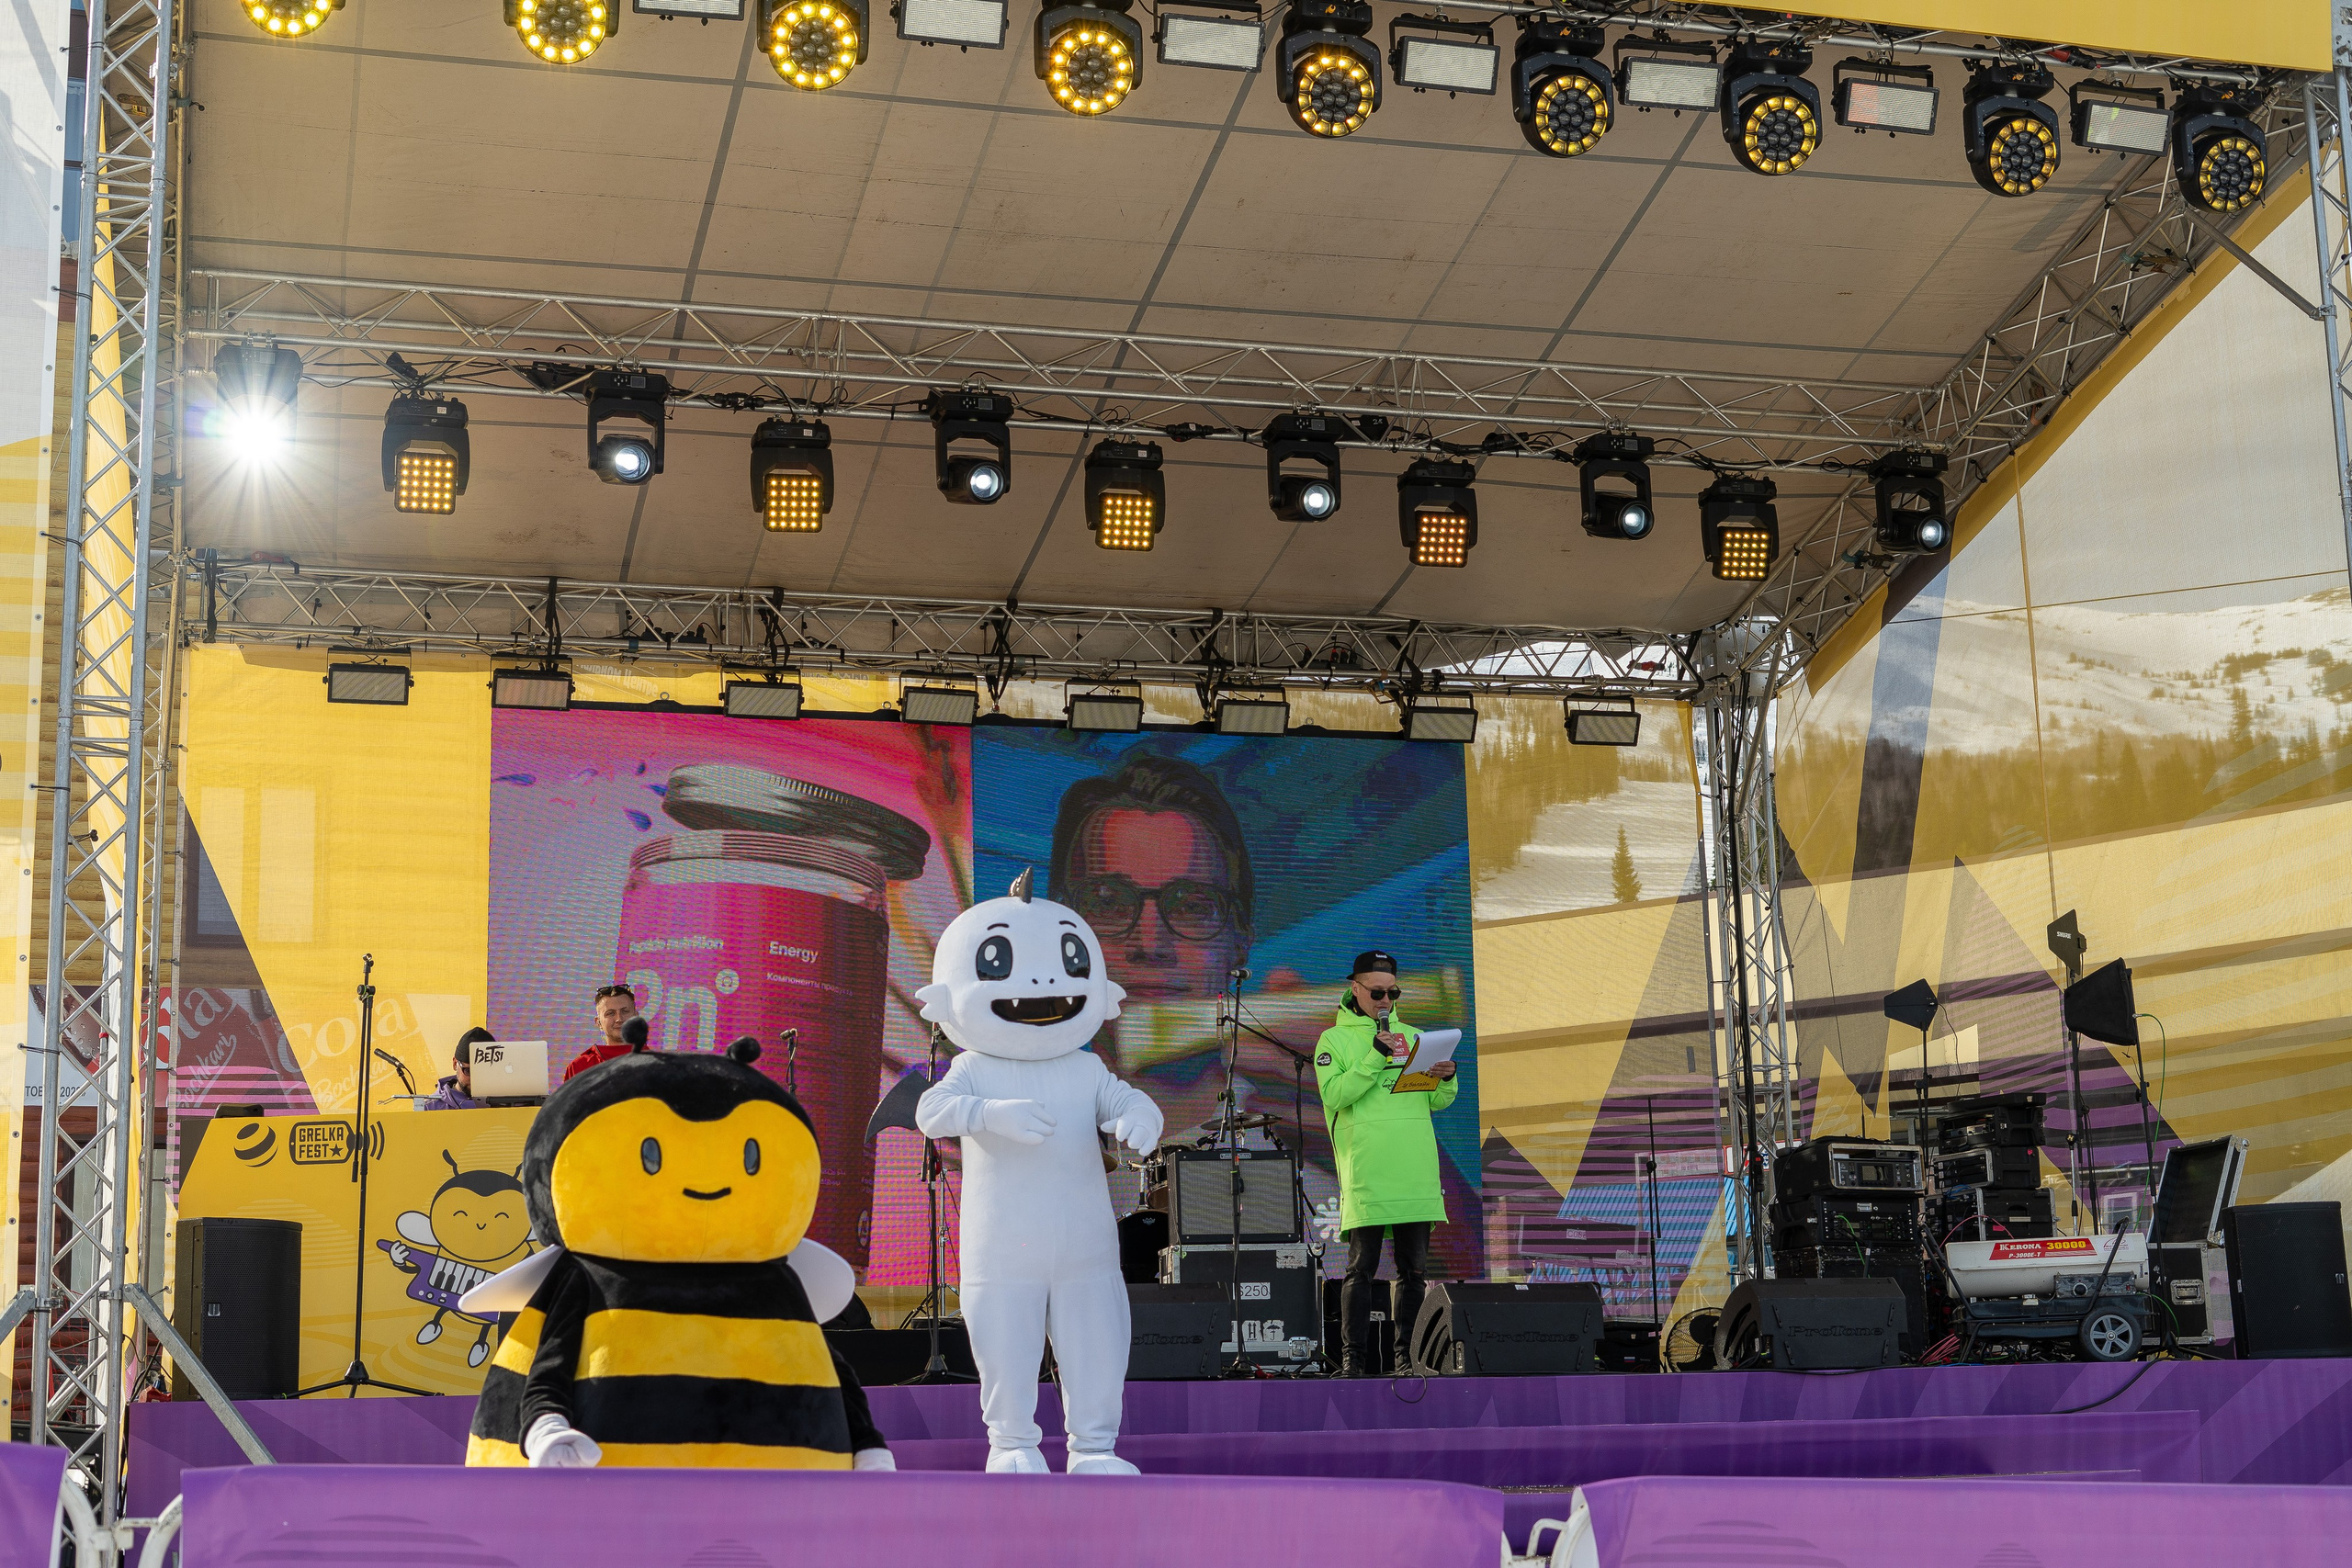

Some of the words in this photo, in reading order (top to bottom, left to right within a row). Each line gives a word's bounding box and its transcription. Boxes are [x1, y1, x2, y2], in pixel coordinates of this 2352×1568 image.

[623, 668, 659, 698] Центре
[2056, 931, 2072, 939] SHURE
[768, 941, 820, 964] Energy
[765, 972, 820, 988] Компоненты
[277, 996, 410, 1074] Cola
[474, 1045, 504, 1066] BETSI
[299, 1126, 345, 1142] GRELKA
[299, 1143, 329, 1158] FEST
[1999, 1243, 2041, 1251] KERONA
[2046, 1240, 2086, 1250] 30000
[1478, 1331, 1580, 1343] ProTone
[1787, 1325, 1884, 1337] ProTone
[1130, 1333, 1204, 1346] oTone
